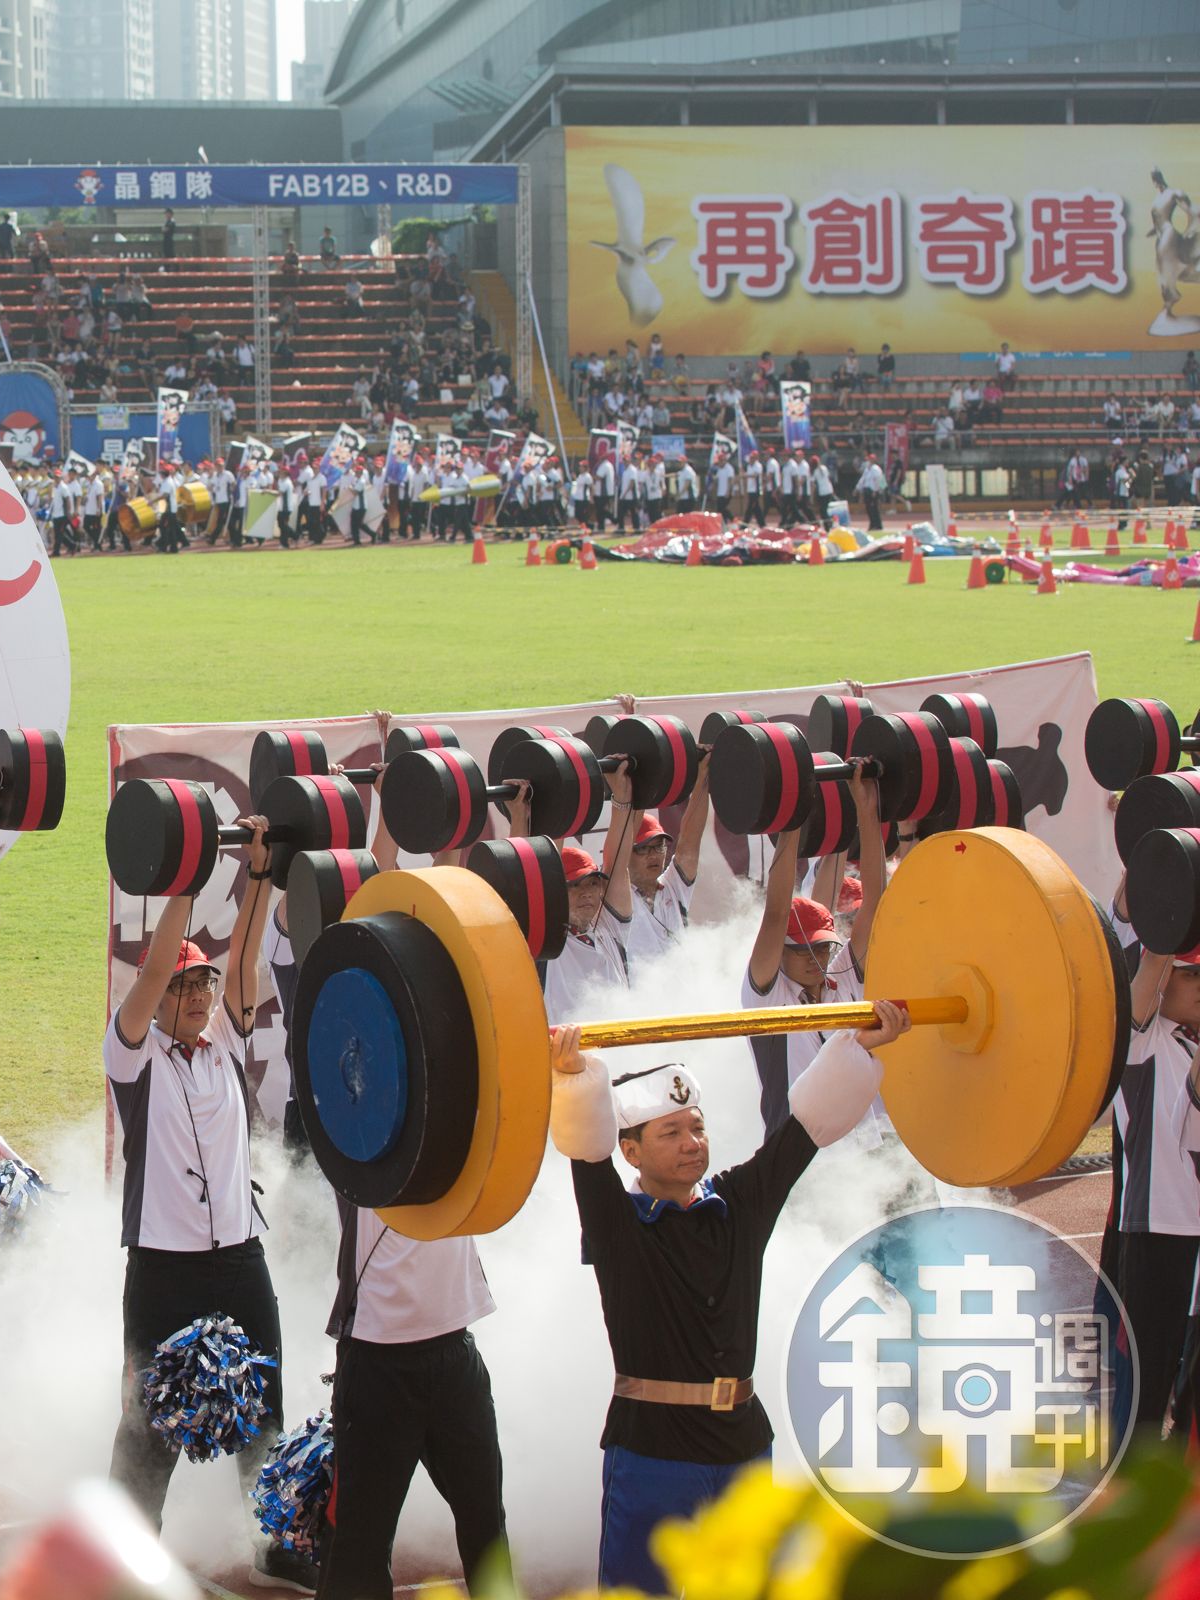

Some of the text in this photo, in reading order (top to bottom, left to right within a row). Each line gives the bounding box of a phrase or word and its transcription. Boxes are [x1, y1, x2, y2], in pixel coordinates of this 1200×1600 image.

[114, 171, 213, 200] 晶鋼隊
[396, 173, 452, 197] R&D
[696, 193, 1122, 293] 再創奇蹟
